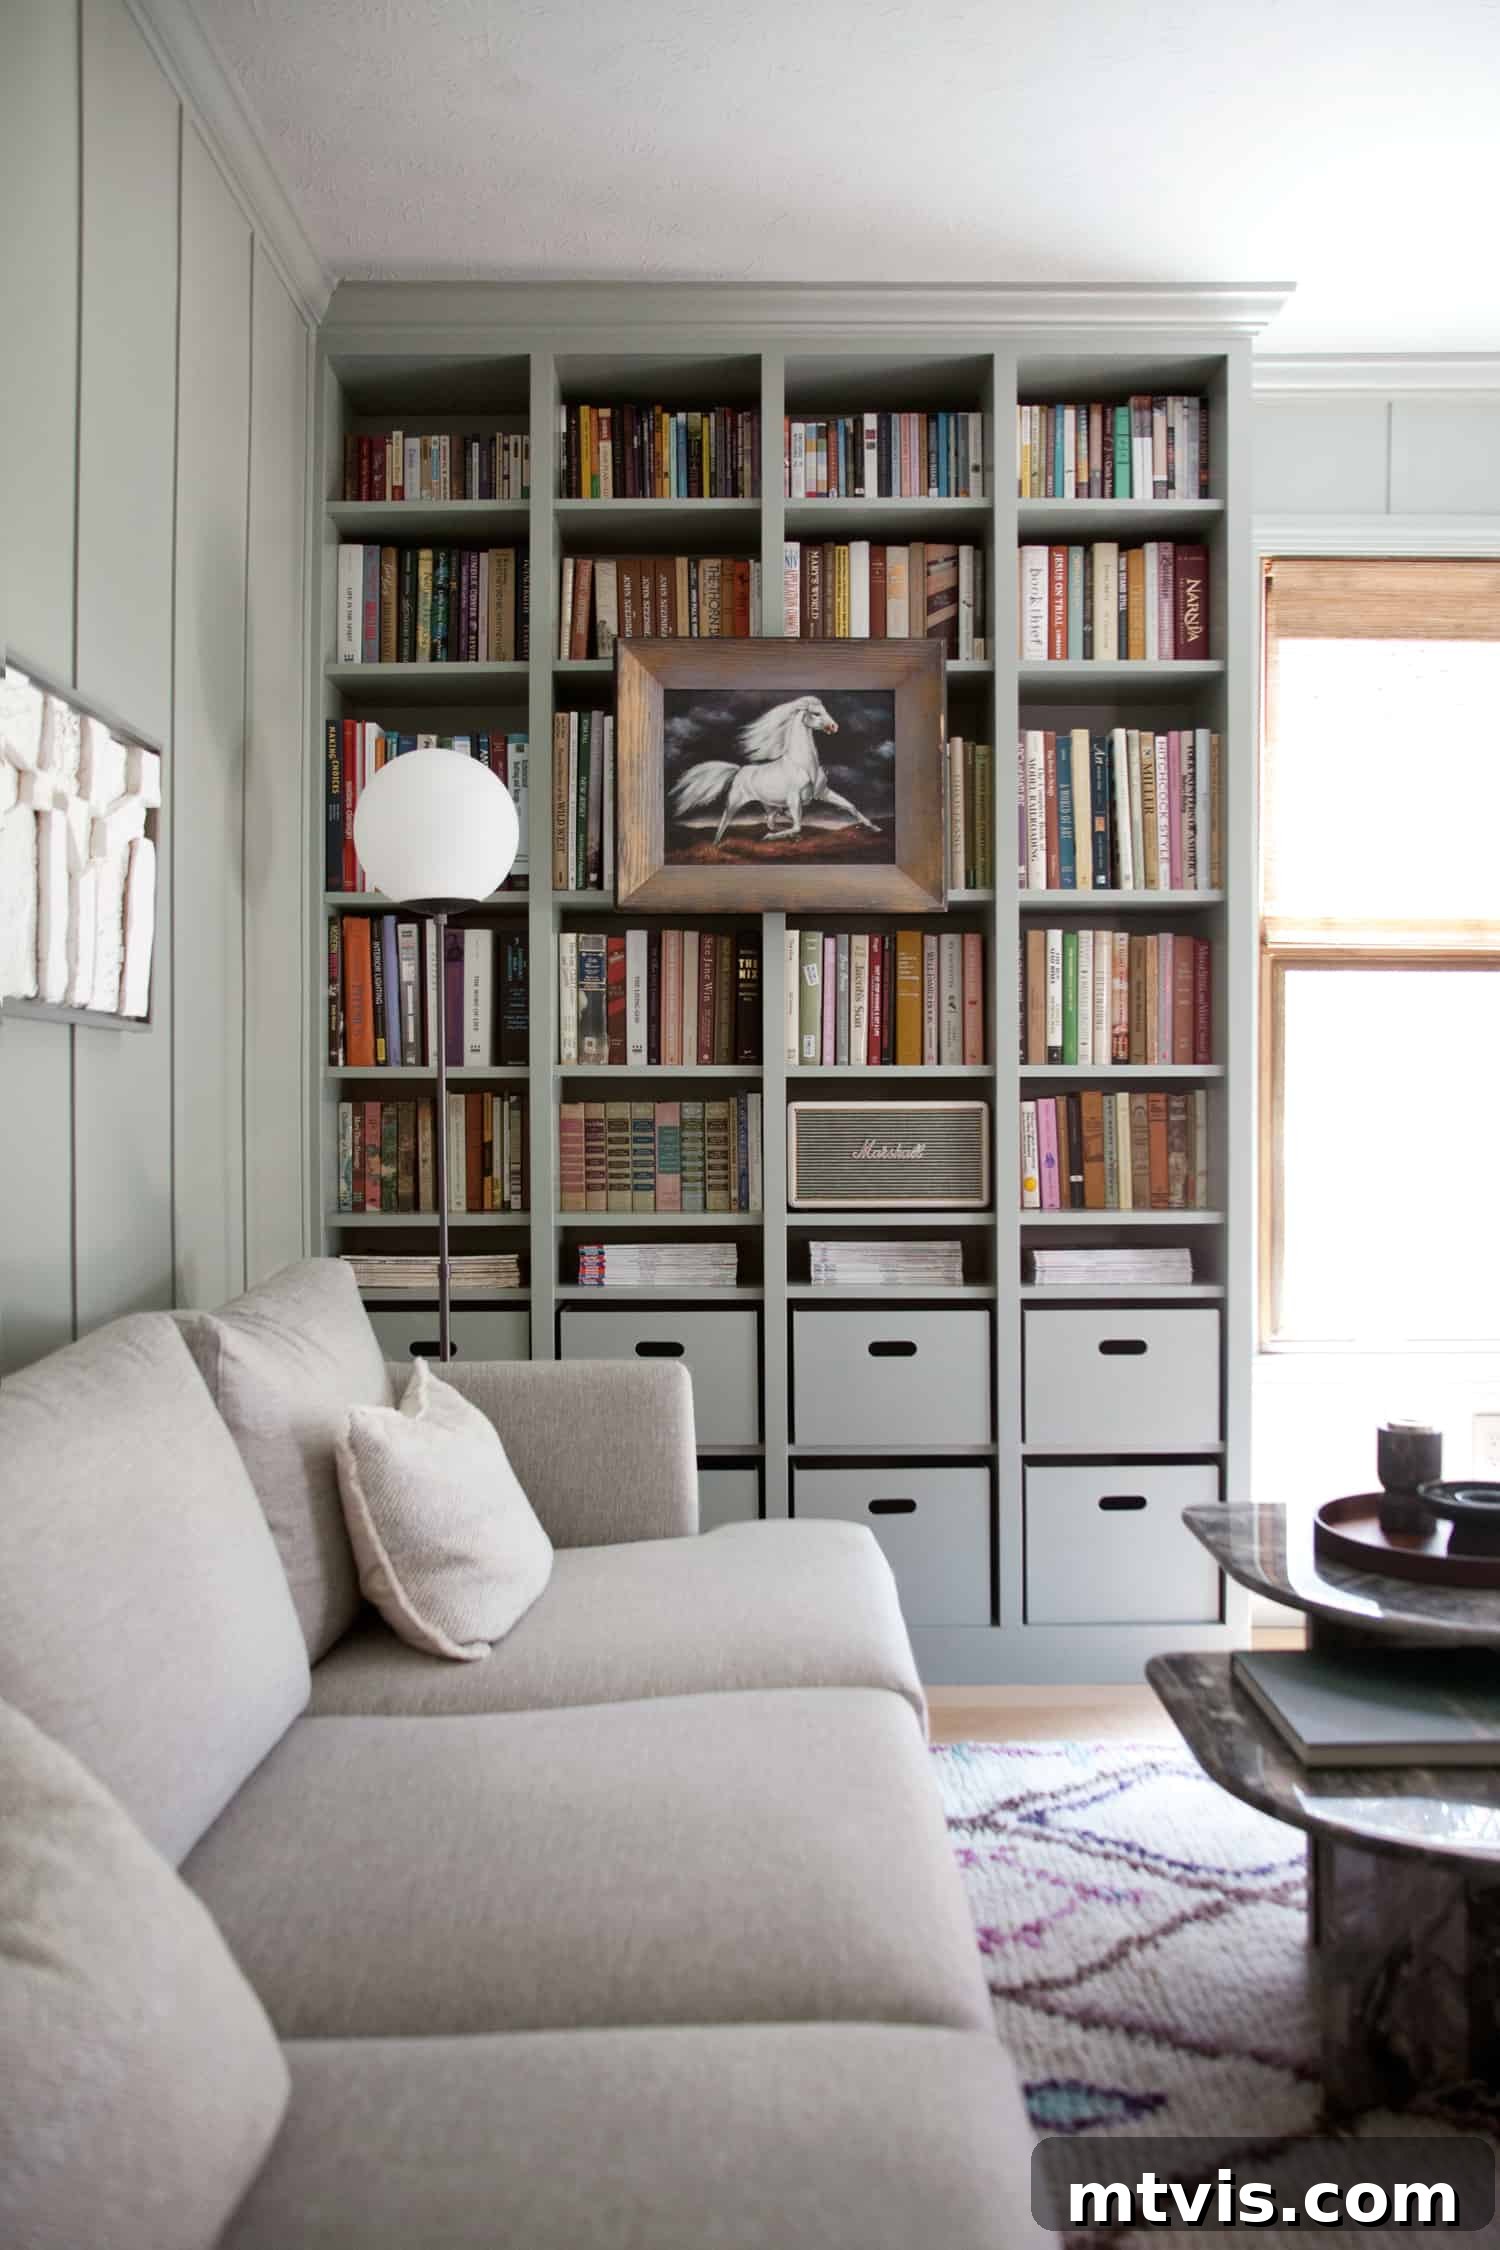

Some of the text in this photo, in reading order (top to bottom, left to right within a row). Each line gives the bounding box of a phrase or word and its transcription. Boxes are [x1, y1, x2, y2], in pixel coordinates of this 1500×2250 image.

[1055, 552, 1065, 580] JESUS
[709, 583, 720, 626] THORN
[1055, 582, 1065, 597] ON
[1055, 599, 1065, 627] TRIAL
[1184, 577, 1204, 642] NARNIA
[328, 726, 338, 759] MAKING
[331, 760, 342, 794] CHOICES
[1143, 763, 1155, 815] MILLER
[556, 800, 567, 829] WILD
[1159, 738, 1169, 863] HITCHCOCK STYLE
[1028, 796, 1039, 863] RAILROADING
[1061, 827, 1073, 840] ART
[373, 941, 384, 1006] INTERIOR LIGHTING
[703, 936, 713, 1002] See Jane Win
[855, 963, 867, 1029] Jacob's Son
[851, 1138, 927, 1160] Marshall
